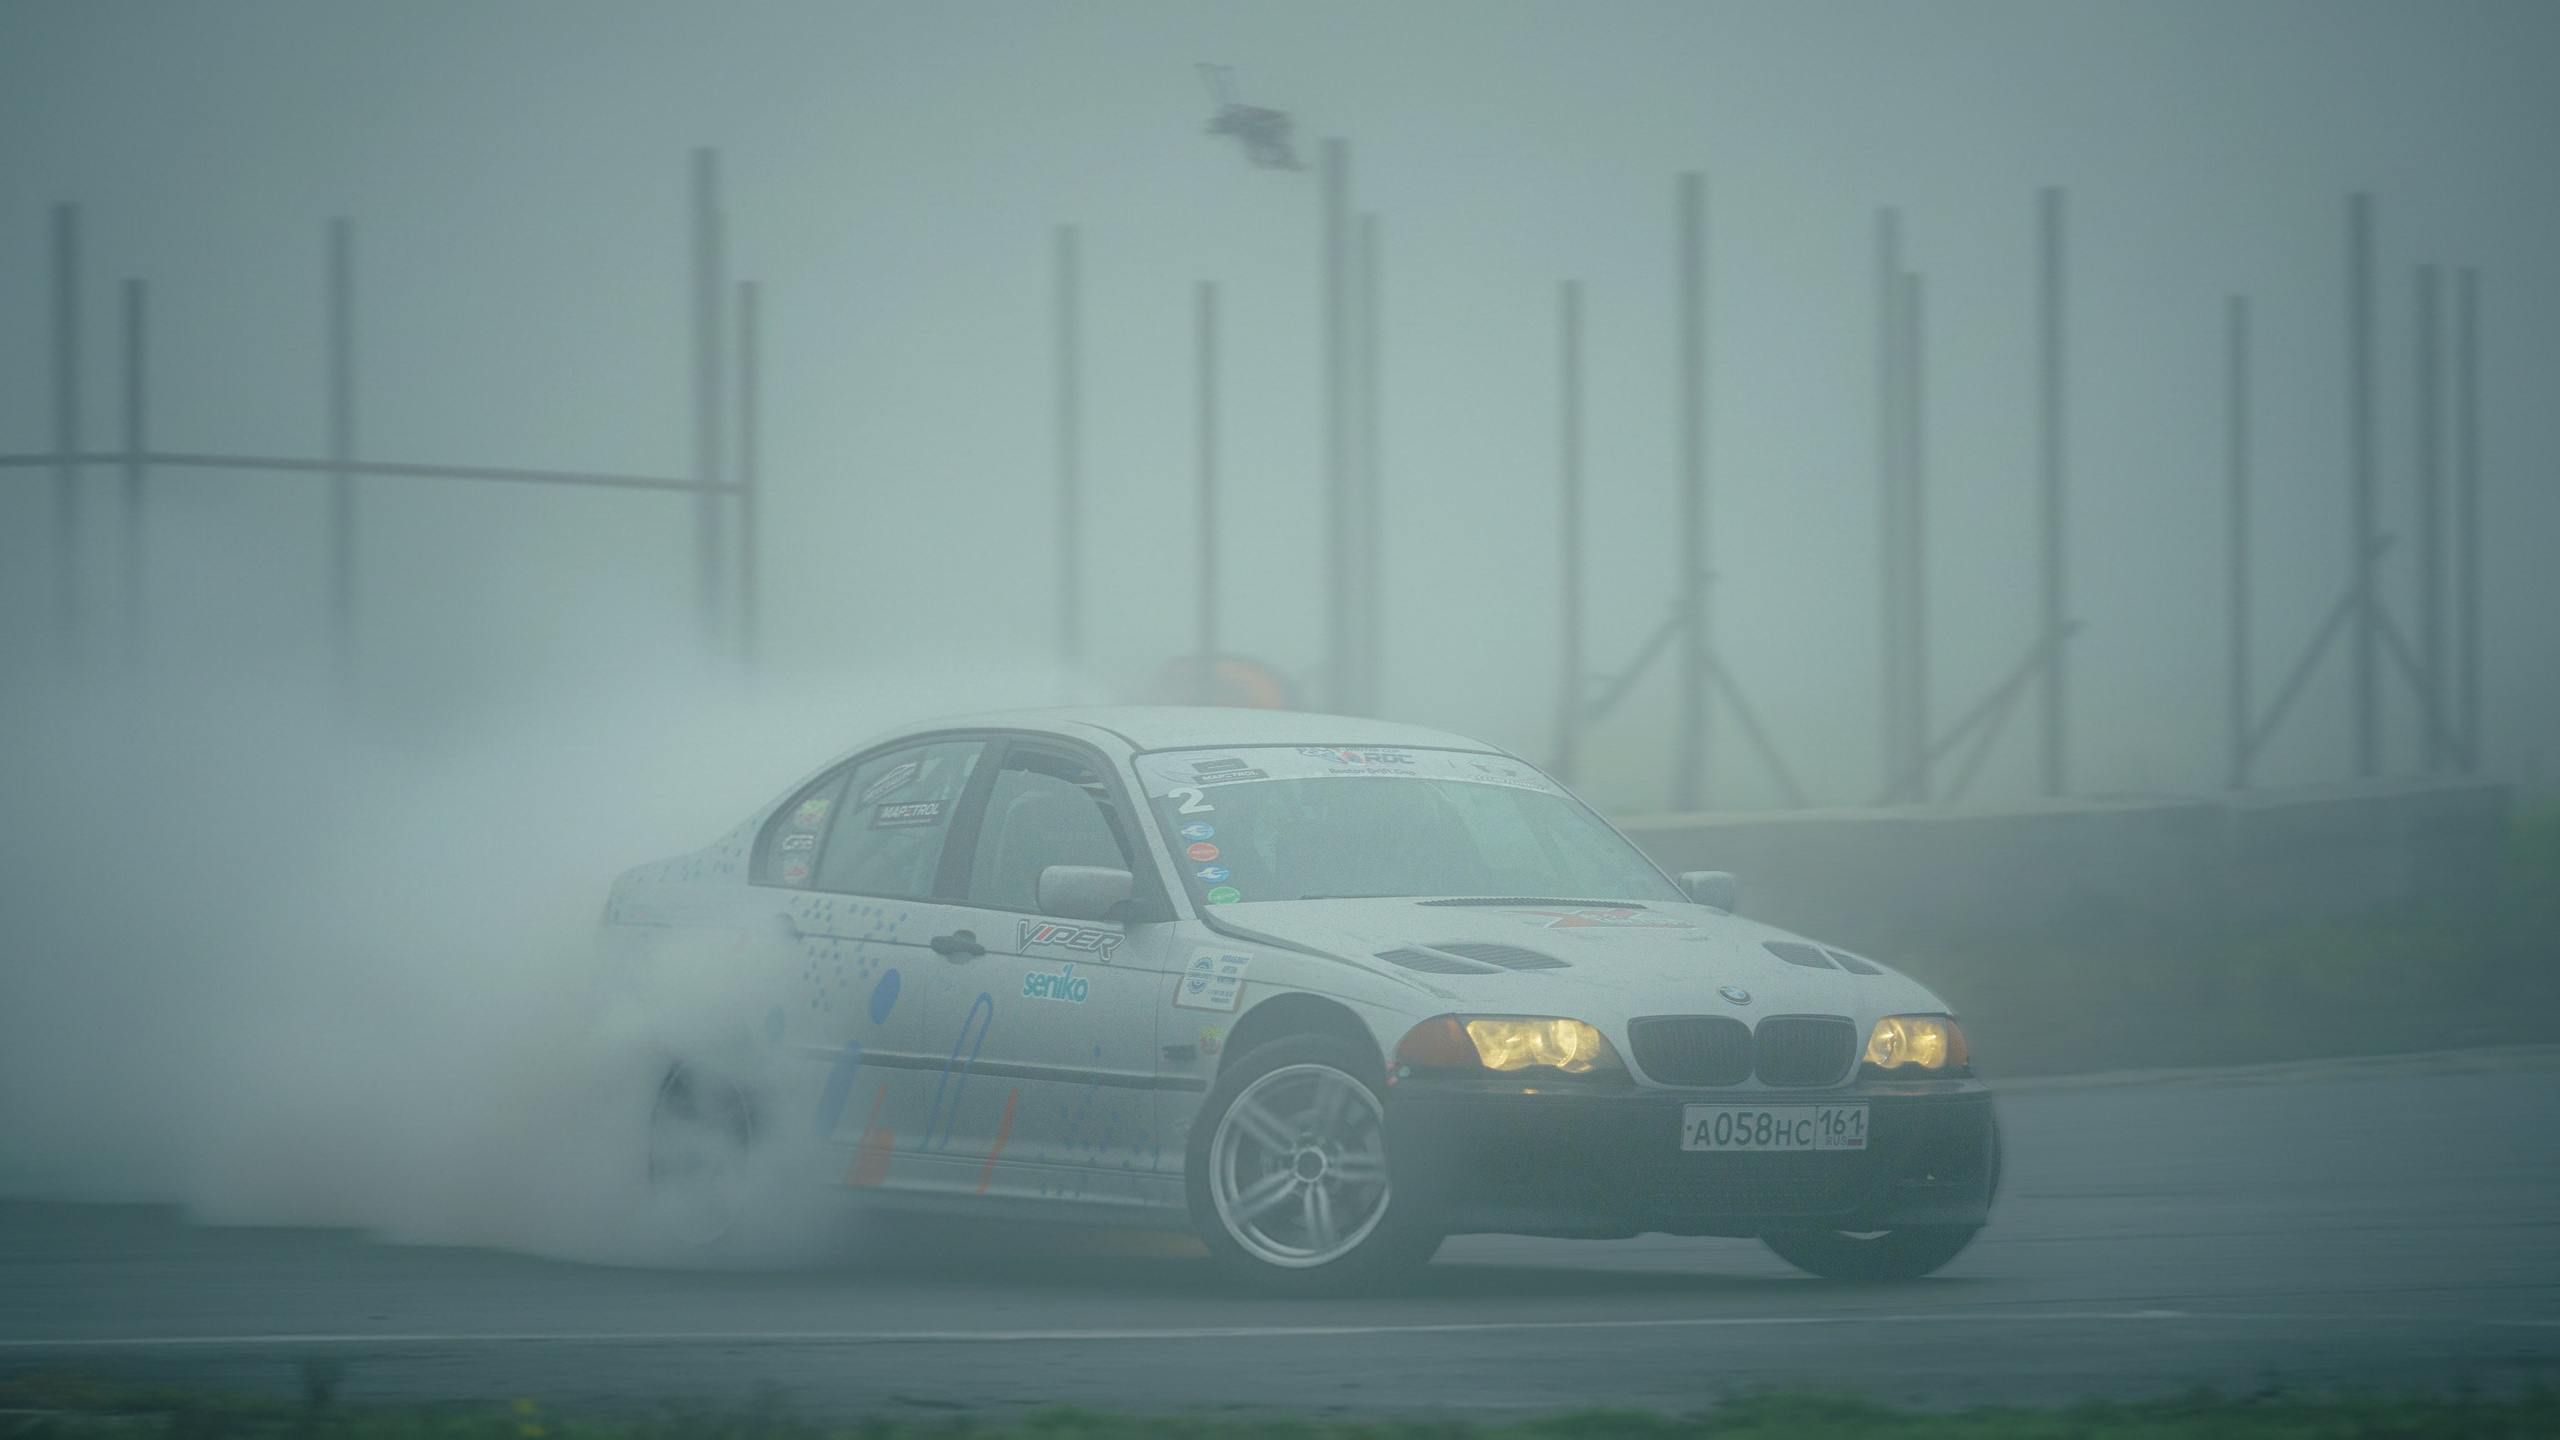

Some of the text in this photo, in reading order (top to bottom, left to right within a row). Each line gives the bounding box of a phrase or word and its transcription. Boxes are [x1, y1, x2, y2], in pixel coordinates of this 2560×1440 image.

[1364, 752, 1415, 764] RDC
[1393, 768, 1416, 777] Cup
[881, 803, 940, 818] MAPETROL
[1168, 787, 1215, 815] 2
[1017, 919, 1127, 962] VIPER
[1021, 962, 1089, 1004] seniko
[1819, 1109, 1862, 1136] 161
[1826, 1137, 1847, 1147] RUS
